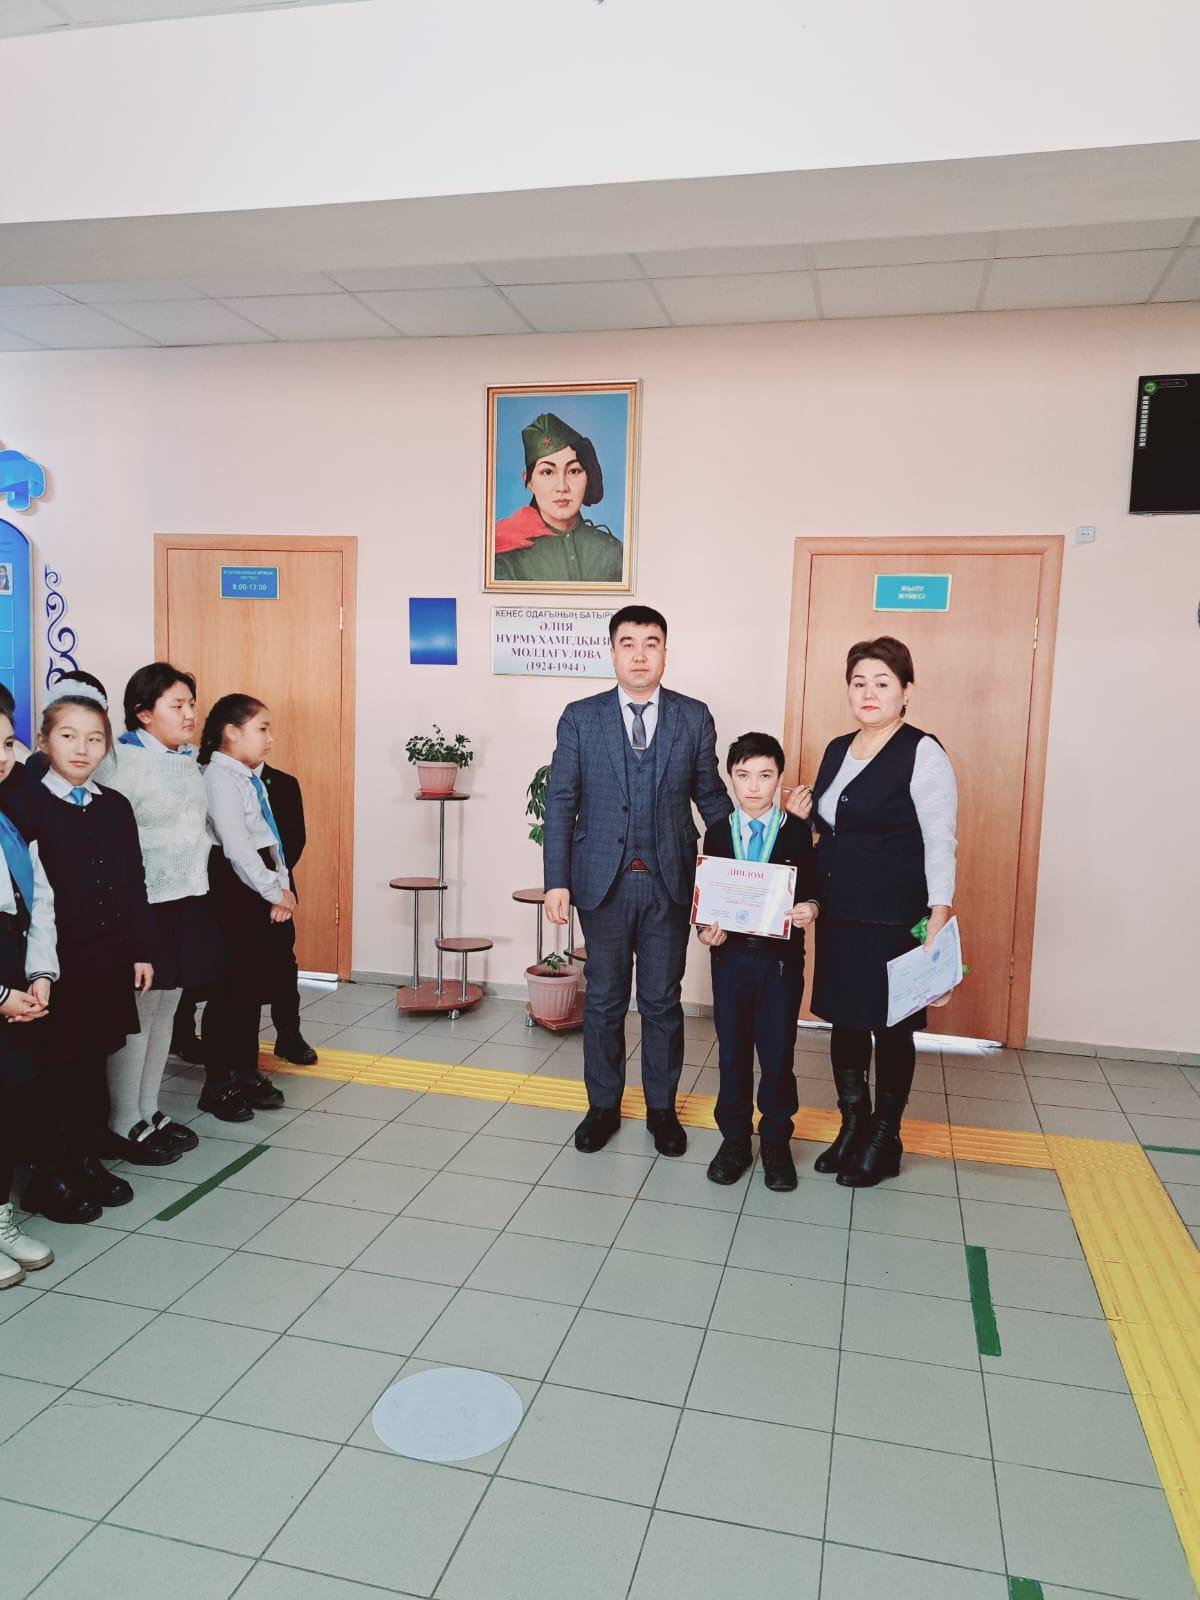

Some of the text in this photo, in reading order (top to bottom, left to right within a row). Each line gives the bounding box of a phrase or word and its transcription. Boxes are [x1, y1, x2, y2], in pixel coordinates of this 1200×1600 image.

[495, 609, 613, 620] КЕҢЕС ОДАҒЫНЫҢ БАТЫР
[540, 622, 573, 631] ӘЛИЯ
